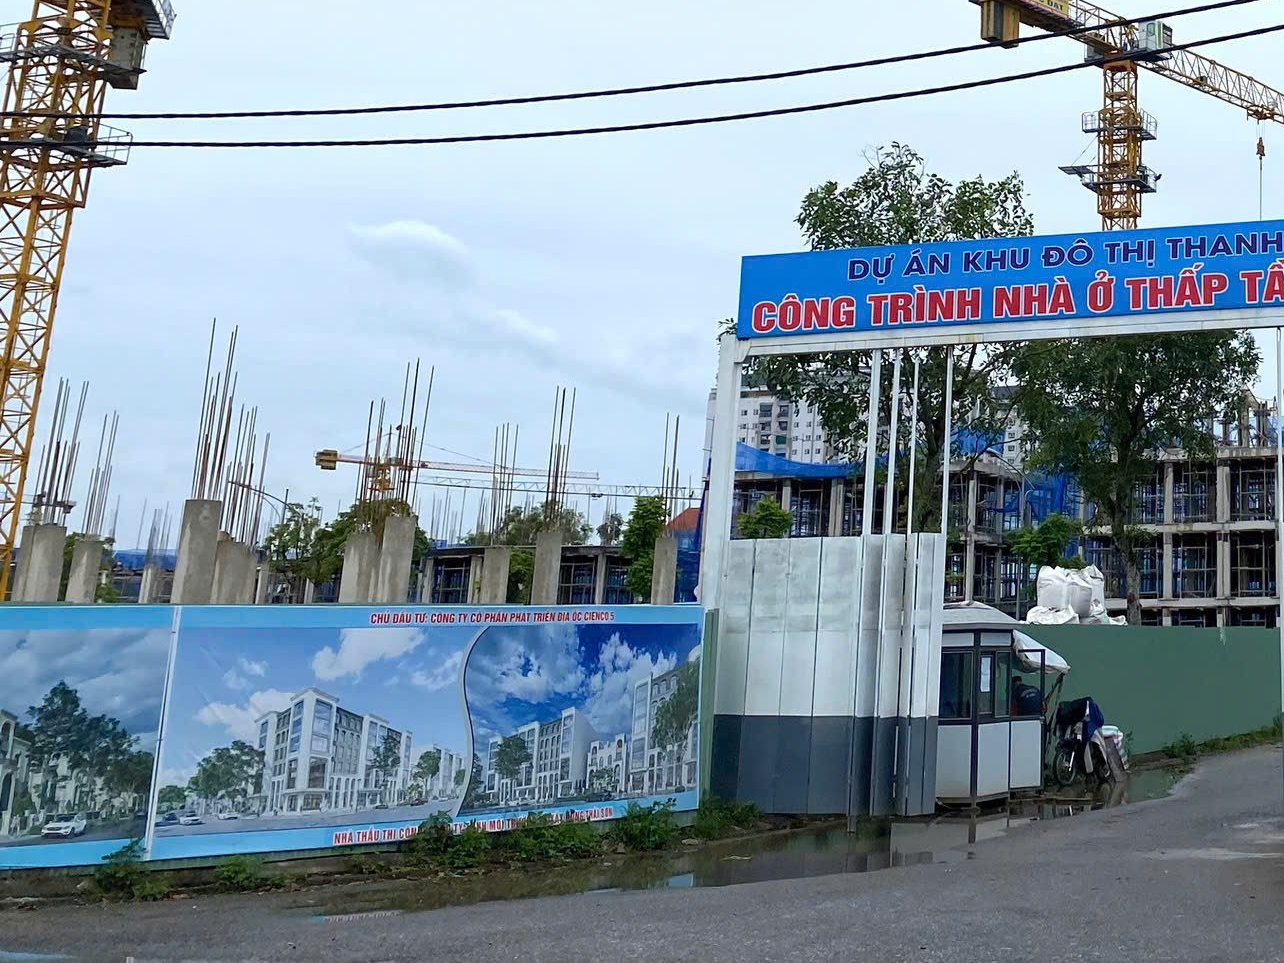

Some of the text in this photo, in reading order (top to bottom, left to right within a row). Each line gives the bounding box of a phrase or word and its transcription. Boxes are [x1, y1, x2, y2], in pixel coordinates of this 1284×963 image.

[849, 253, 895, 284] DỰ
[903, 248, 951, 277] ÁN
[962, 247, 1031, 273] KHU
[1041, 238, 1094, 268] ĐÔ
[1104, 239, 1156, 267] THỊ
[1166, 230, 1284, 260] THANH
[751, 293, 856, 333] CÔNG
[867, 283, 982, 325] TRÌNH
[993, 276, 1076, 318] NHÀ
[1086, 269, 1114, 313] Ở
[1125, 262, 1228, 311] THẤP
[459, 613, 468, 623] TY
[584, 611, 609, 621] CIENCO
[610, 612, 615, 621] 5
[334, 828, 354, 845] NHÀ
[382, 828, 396, 840] THI
